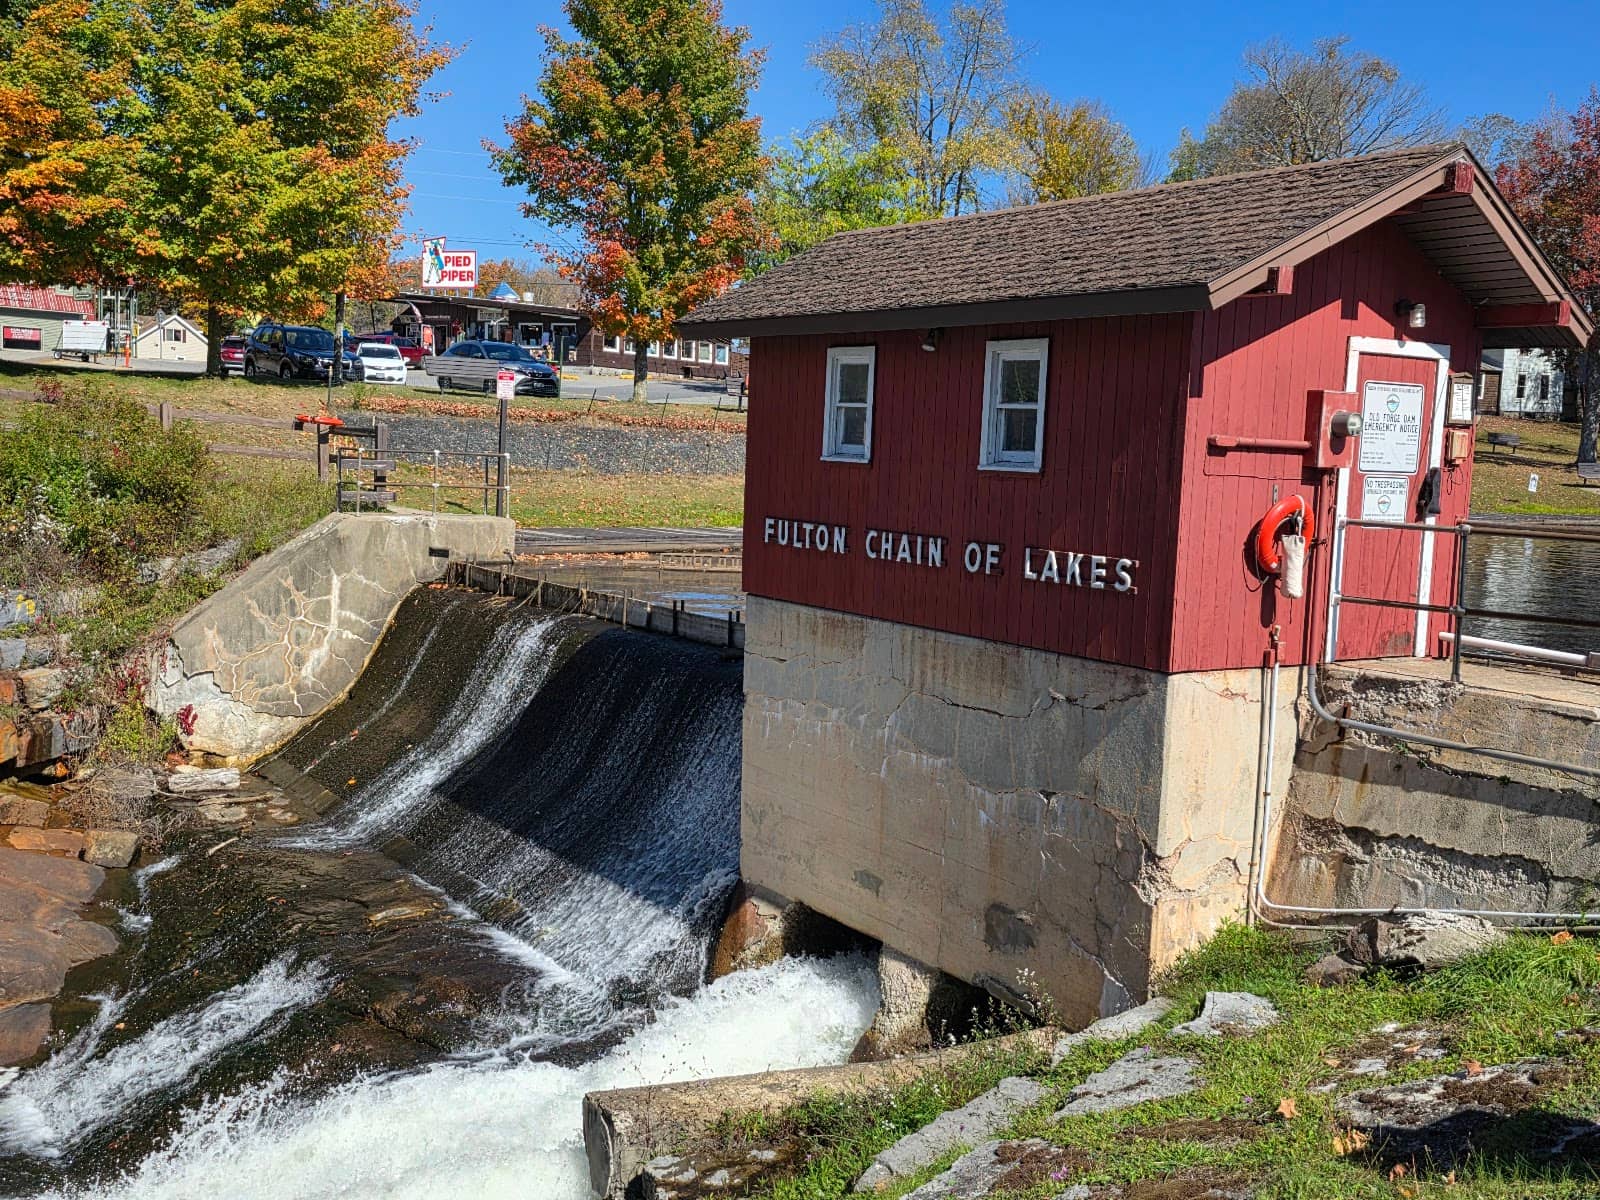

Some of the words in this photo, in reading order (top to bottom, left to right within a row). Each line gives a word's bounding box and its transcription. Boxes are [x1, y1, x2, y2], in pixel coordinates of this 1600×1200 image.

[444, 255, 471, 267] PIED
[441, 270, 474, 281] PIPER
[1369, 412, 1380, 421] OLD
[1384, 413, 1400, 423] FORGE
[1404, 414, 1416, 423] DAM
[1364, 421, 1397, 432] EMERGENCY
[1400, 424, 1419, 433] NOTICE
[1366, 479, 1374, 488] NO
[764, 517, 846, 554] FULTON
[865, 530, 942, 567] CHAIN
[964, 542, 1000, 574] OF
[1024, 547, 1133, 592] LAKES
